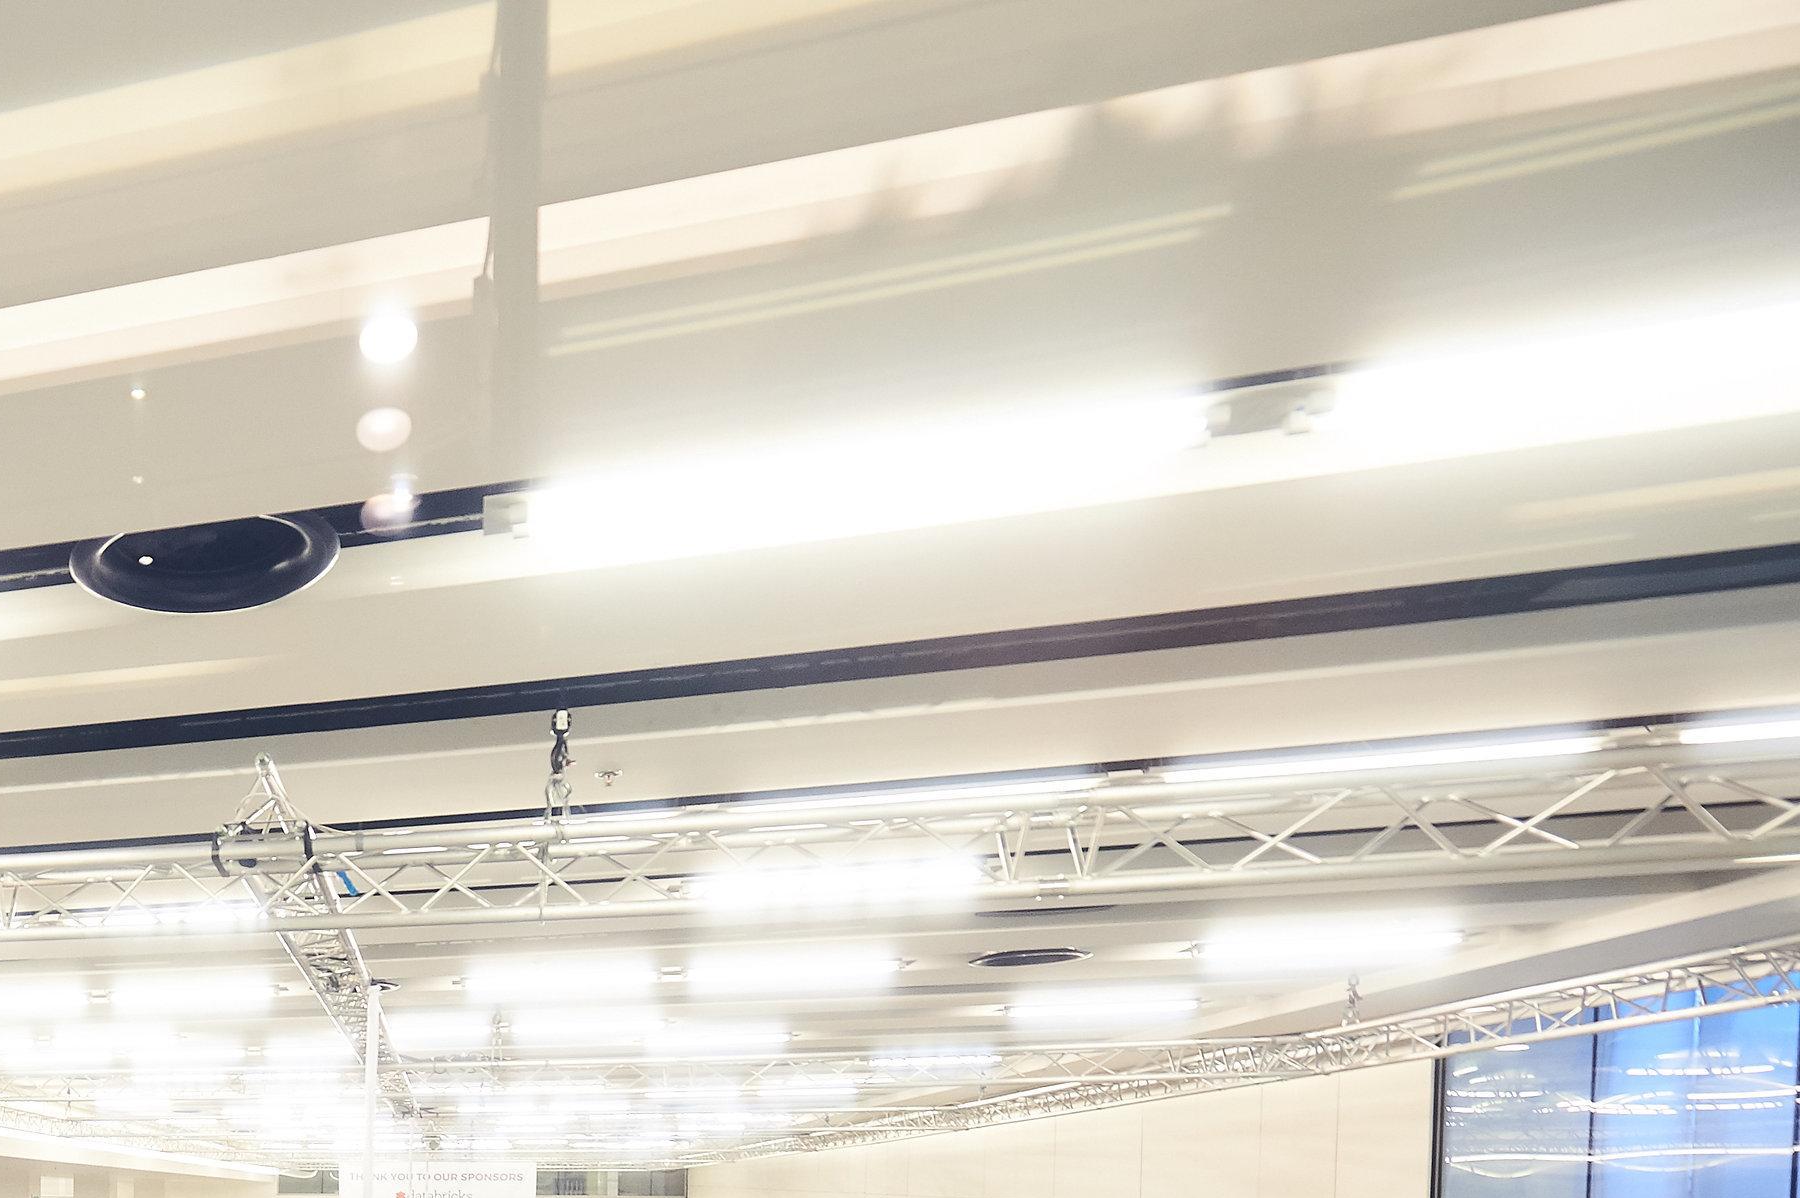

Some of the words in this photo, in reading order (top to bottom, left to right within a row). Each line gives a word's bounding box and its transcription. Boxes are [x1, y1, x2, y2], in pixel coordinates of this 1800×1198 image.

[349, 1172, 388, 1182] THNK
[433, 1172, 458, 1182] OUR
[460, 1172, 524, 1183] SPONSORS
